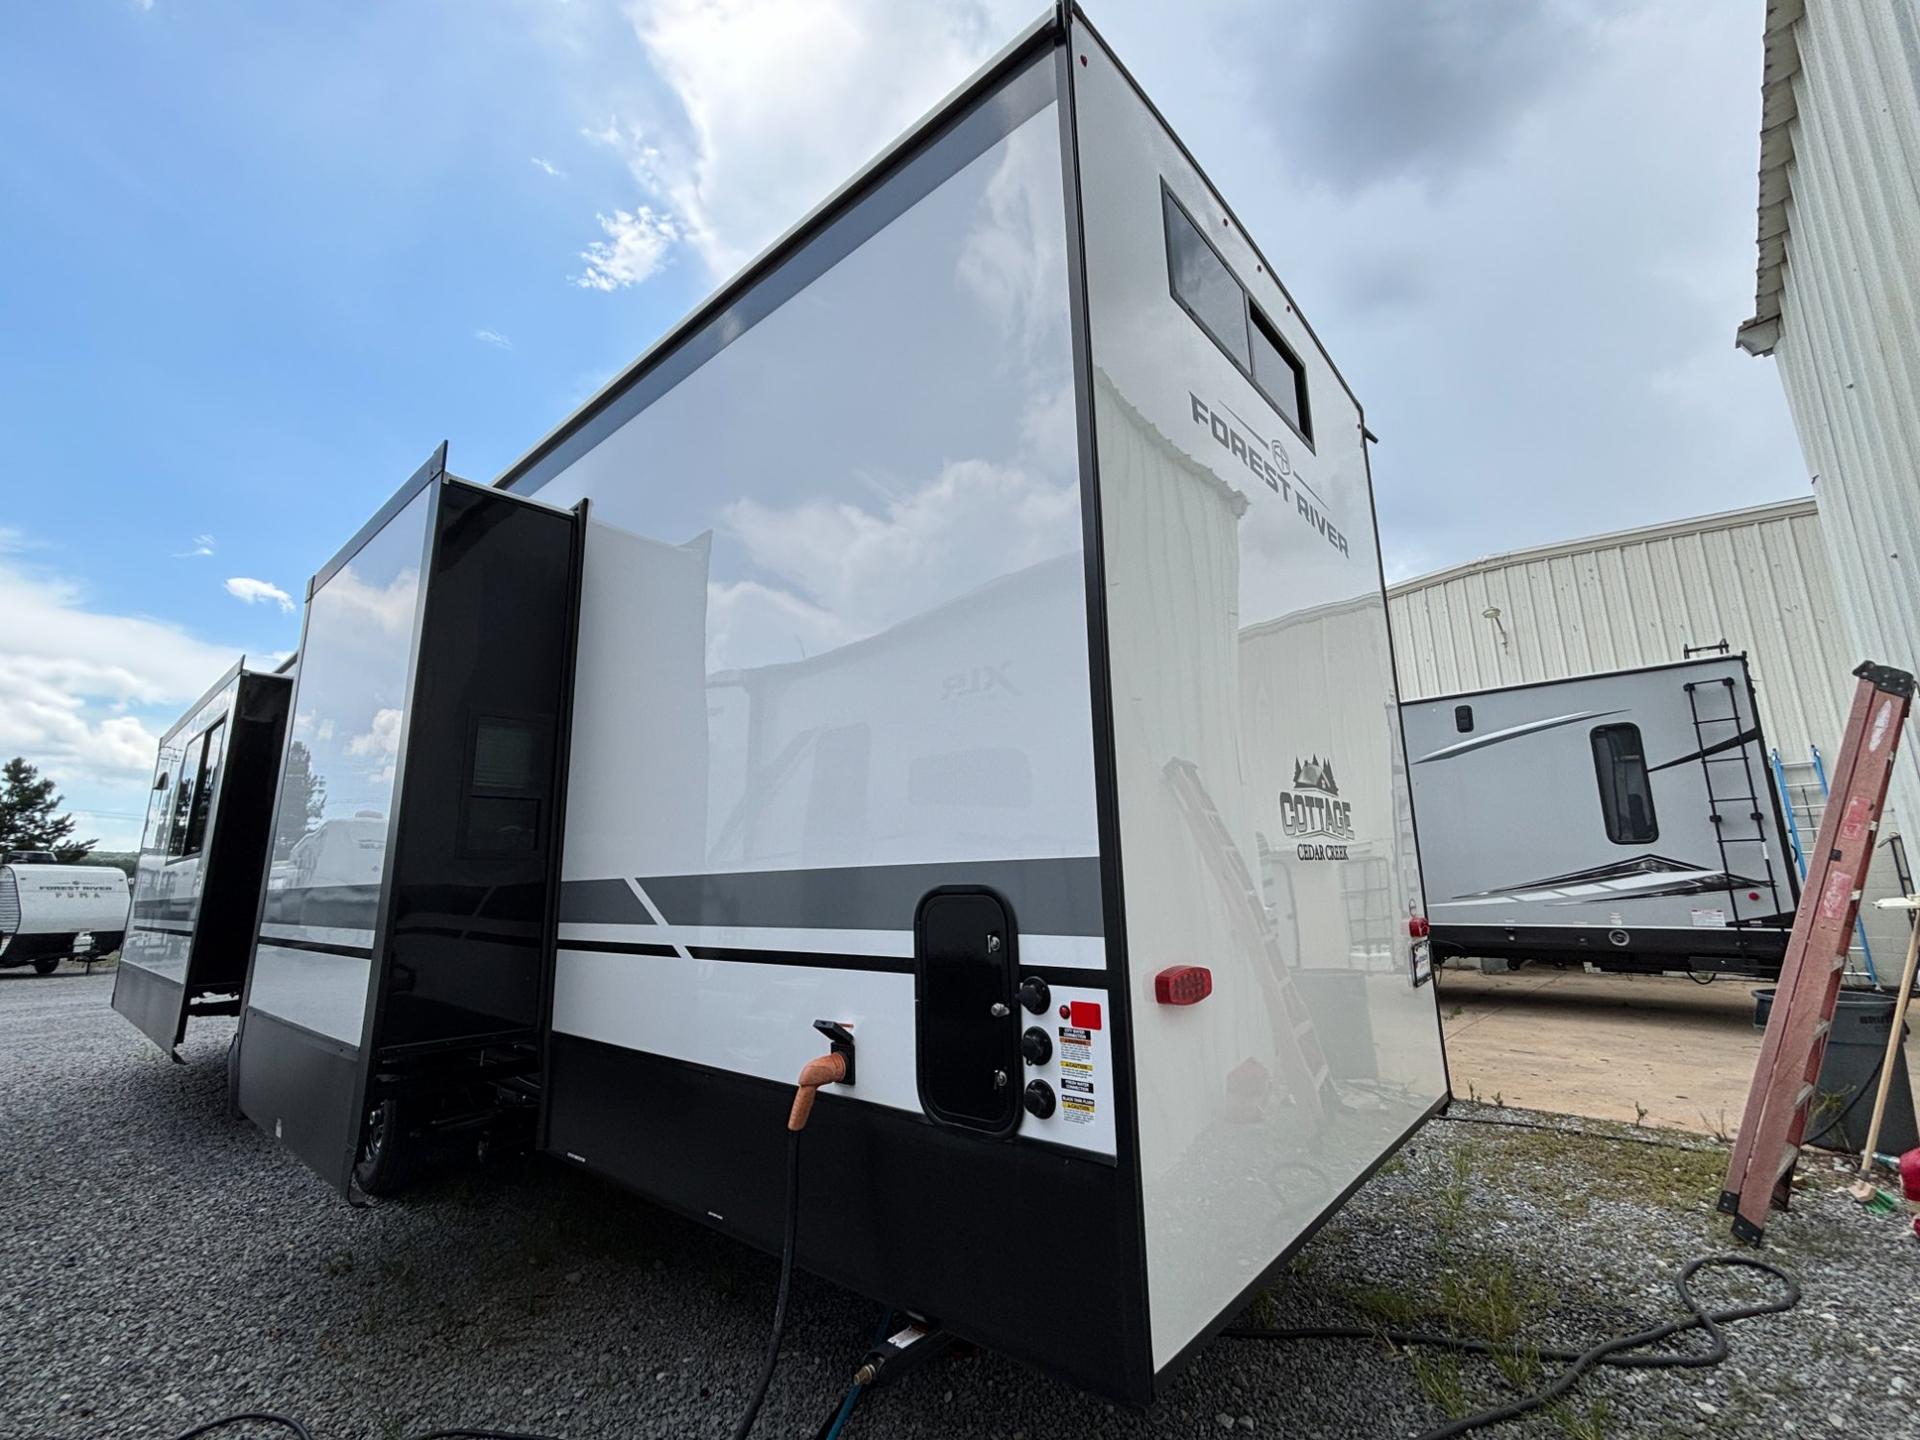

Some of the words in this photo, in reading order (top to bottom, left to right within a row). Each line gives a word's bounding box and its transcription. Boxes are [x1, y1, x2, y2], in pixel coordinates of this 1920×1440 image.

[1189, 391, 1291, 502] FOREST
[1295, 490, 1349, 559] RIVER
[1280, 792, 1355, 840] COTTAGE
[1297, 844, 1325, 860] CEDAR
[1325, 845, 1349, 860] CREEK
